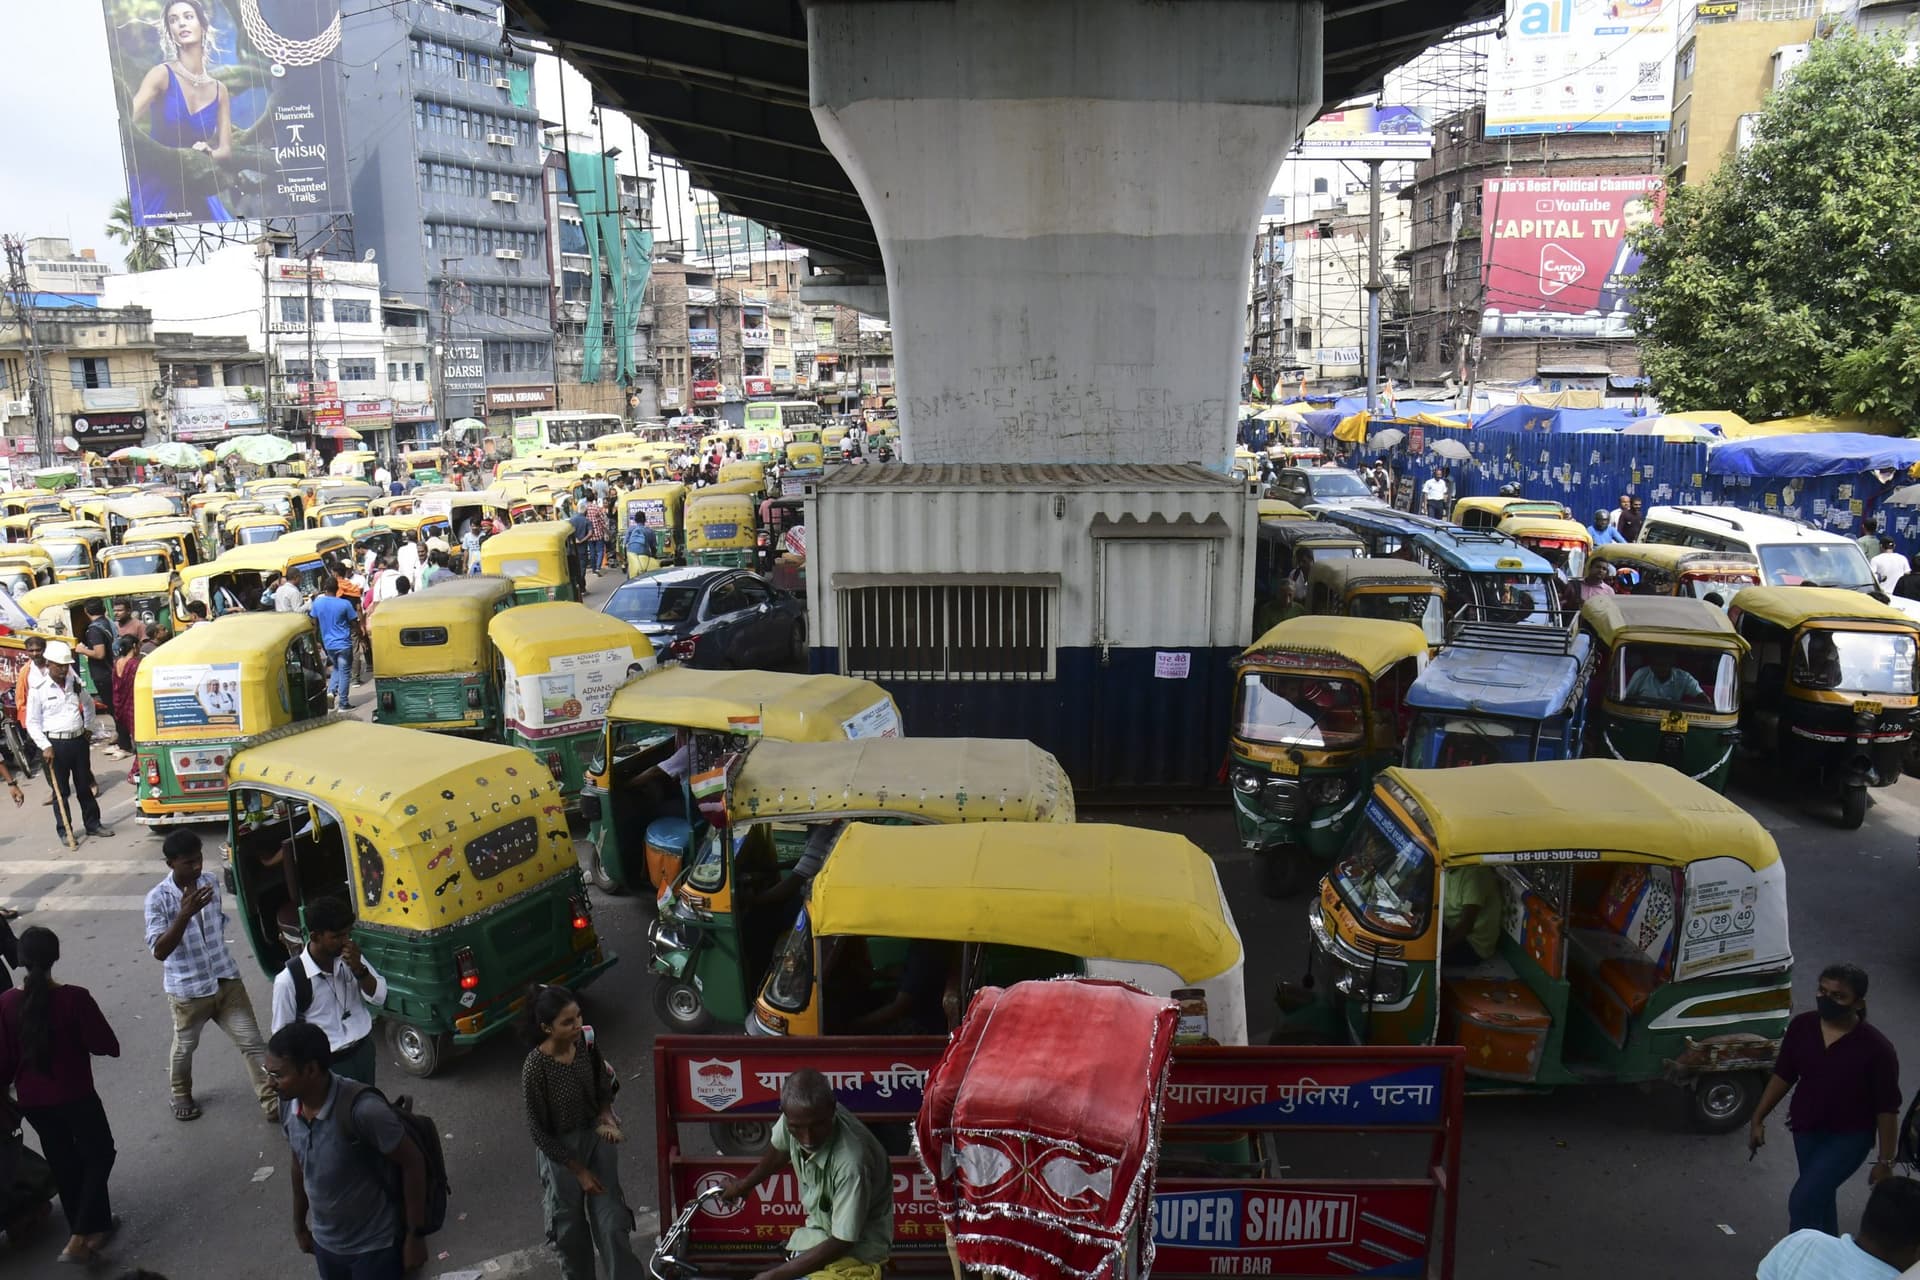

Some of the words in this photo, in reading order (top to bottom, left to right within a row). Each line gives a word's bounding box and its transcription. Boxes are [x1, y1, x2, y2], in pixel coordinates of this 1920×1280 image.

[275, 111, 315, 121] Diamonds
[270, 142, 326, 164] TANISHQ
[277, 181, 327, 194] Enchanted
[1527, 180, 1554, 192] Best
[1553, 179, 1598, 192] Political
[1600, 178, 1645, 191] Channel
[290, 192, 321, 203] Trails
[1556, 198, 1611, 211] YouTube
[1489, 219, 1584, 238] CAPITAL
[1592, 218, 1620, 238] TV
[1544, 260, 1583, 272] CAPITAL
[1558, 271, 1577, 281] TV
[492, 394, 514, 403] PATNA
[418, 780, 556, 842] WELCOME
[476, 863, 544, 901] 2023
[1692, 919, 1699, 929] 6
[1714, 914, 1727, 925] 28
[1738, 911, 1751, 921] 40
[871, 1062, 928, 1098] पुलि
[1168, 1084, 1267, 1104] यातायात
[1371, 1084, 1434, 1105] पटना
[1246, 1197, 1349, 1242] SHAKTI
[1210, 1256, 1240, 1274] TMT
[1242, 1257, 1271, 1275] BAR
